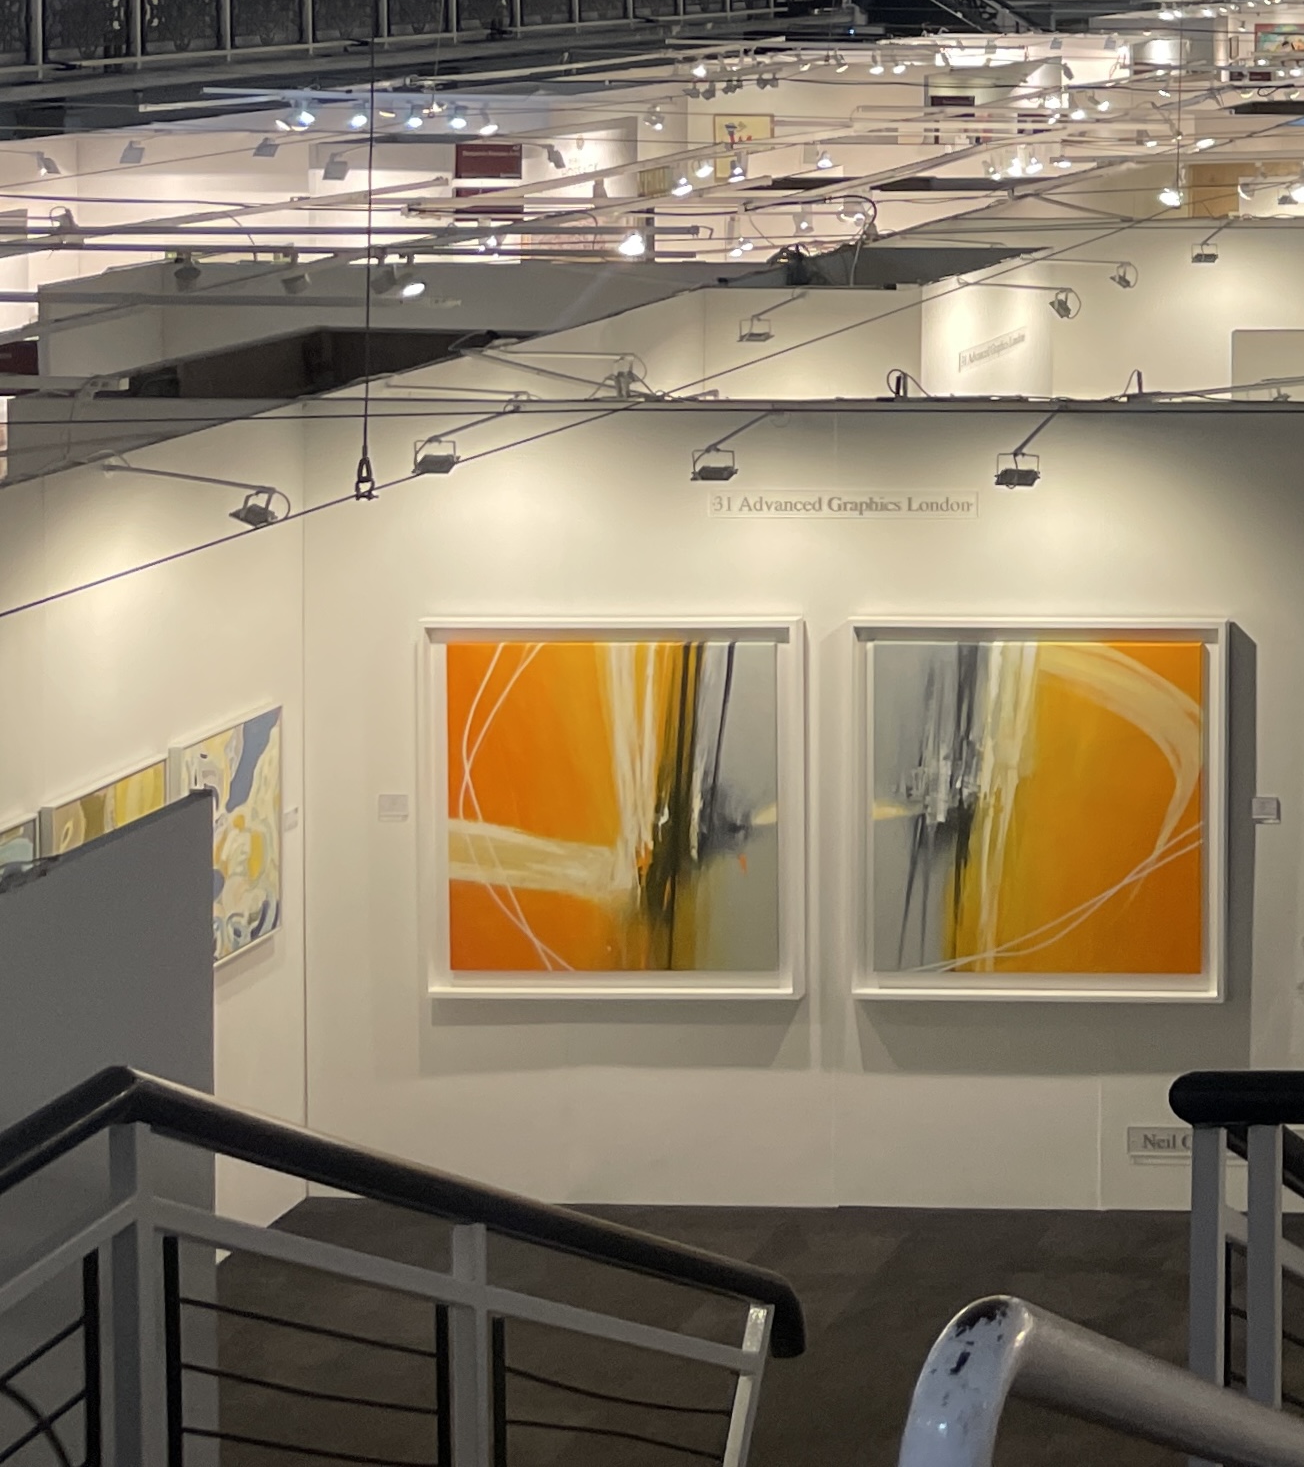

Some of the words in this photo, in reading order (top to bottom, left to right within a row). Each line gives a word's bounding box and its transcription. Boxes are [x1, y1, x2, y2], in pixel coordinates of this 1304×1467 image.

[713, 496, 732, 512] 31
[739, 496, 823, 513] Advanced
[827, 496, 902, 516] Graphics
[907, 496, 971, 513] London
[1143, 1134, 1176, 1150] Neil
